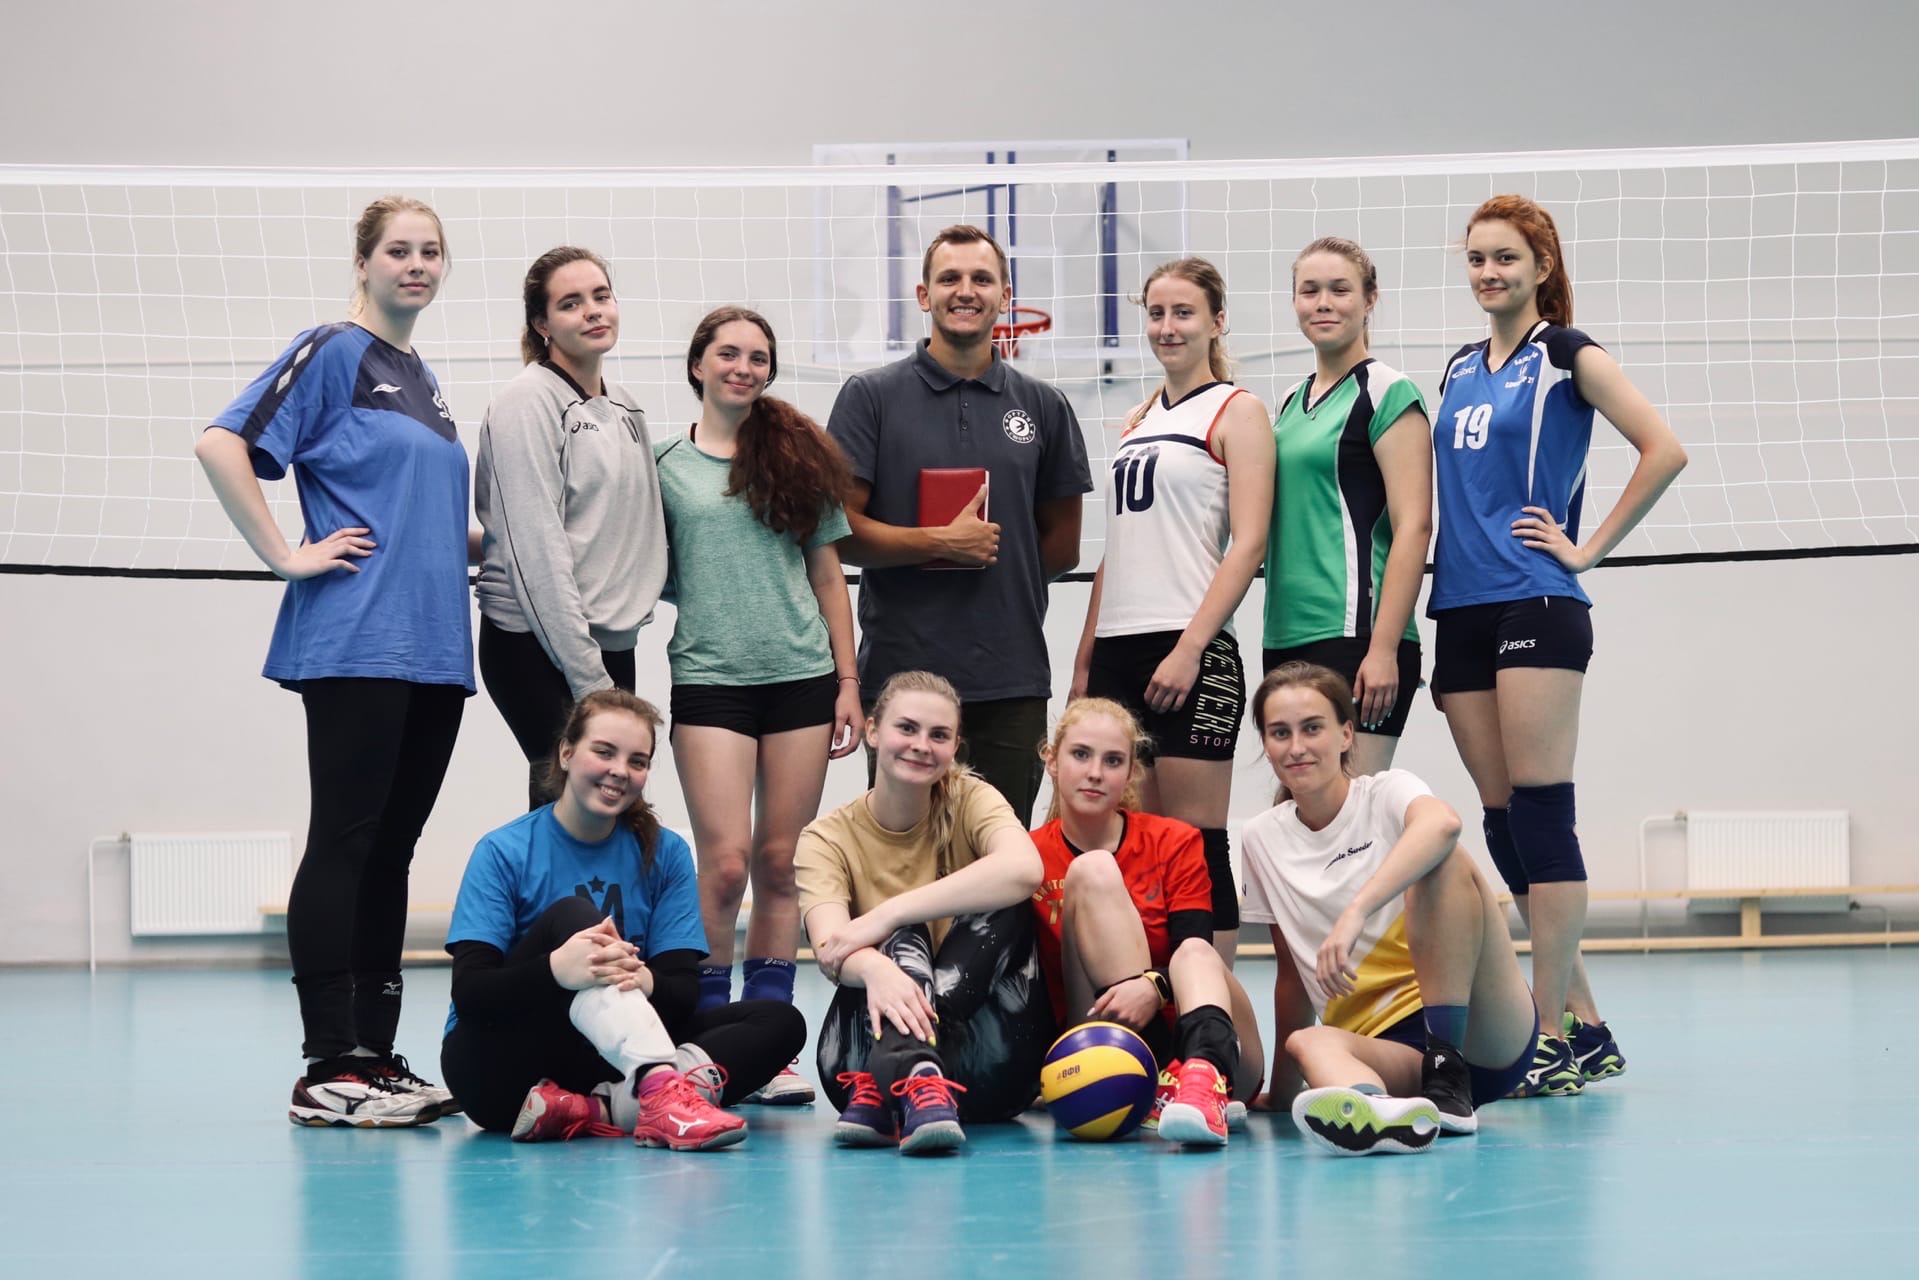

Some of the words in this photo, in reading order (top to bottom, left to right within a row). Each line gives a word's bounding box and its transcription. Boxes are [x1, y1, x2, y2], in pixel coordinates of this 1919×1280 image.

[1453, 403, 1493, 450] 19
[1112, 446, 1160, 516] 10
[1189, 734, 1231, 747] STOP
